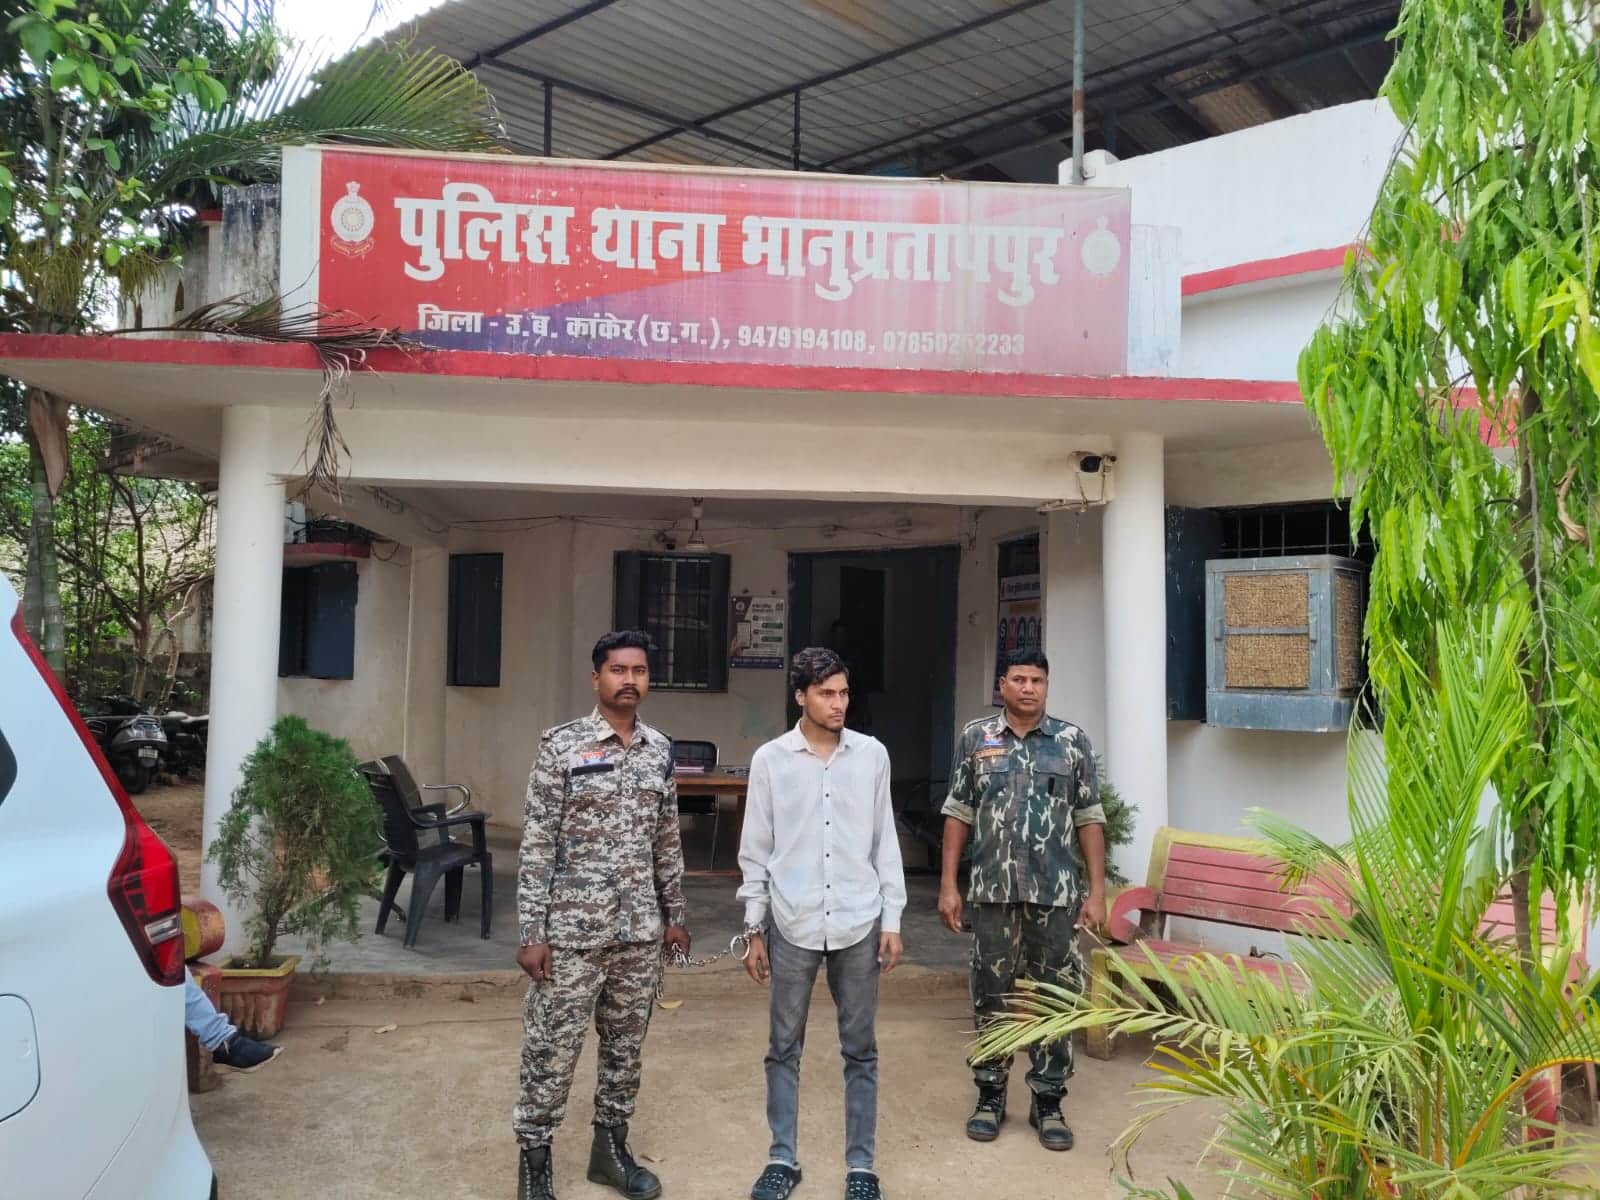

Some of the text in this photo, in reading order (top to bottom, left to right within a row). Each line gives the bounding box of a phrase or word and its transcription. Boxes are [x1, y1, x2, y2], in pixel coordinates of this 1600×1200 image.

[393, 182, 1063, 306] पुलिस थाना भानुप्रतापपुर
[417, 304, 484, 334] जिला
[738, 325, 876, 355] 9479194108,
